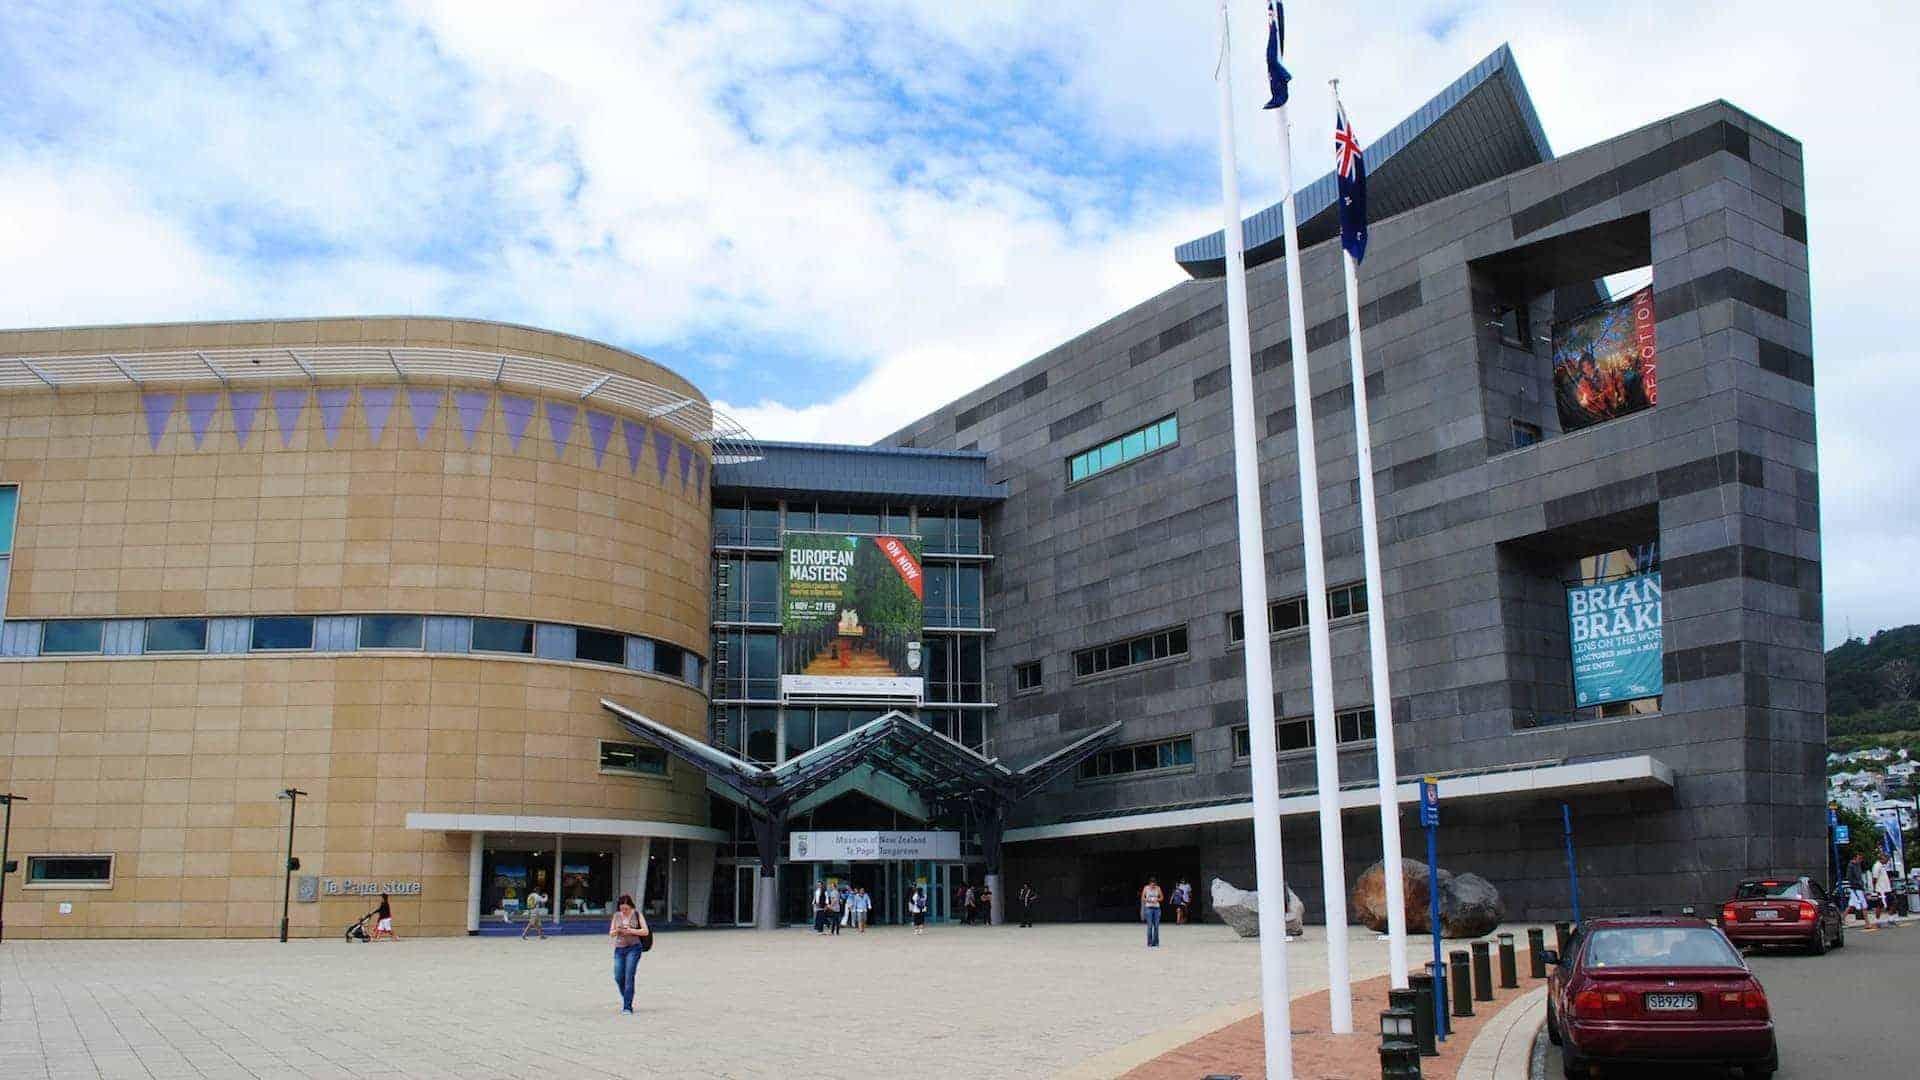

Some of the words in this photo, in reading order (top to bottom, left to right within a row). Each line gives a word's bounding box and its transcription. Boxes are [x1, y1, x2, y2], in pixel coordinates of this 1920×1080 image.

[789, 549, 854, 567] EUROPEAN
[886, 540, 901, 557] ON
[898, 555, 920, 580] NOW
[789, 565, 847, 582] MASTERS
[1570, 576, 1662, 616] BRIAN
[1574, 640, 1597, 653] LENS
[1598, 638, 1613, 649] ON
[1617, 633, 1636, 647] THE
[835, 835, 868, 844] Museum
[879, 835, 896, 844] New
[898, 835, 926, 844] Zealand
[325, 880, 337, 892] Te
[343, 880, 377, 894] Papa
[383, 880, 422, 893] store
